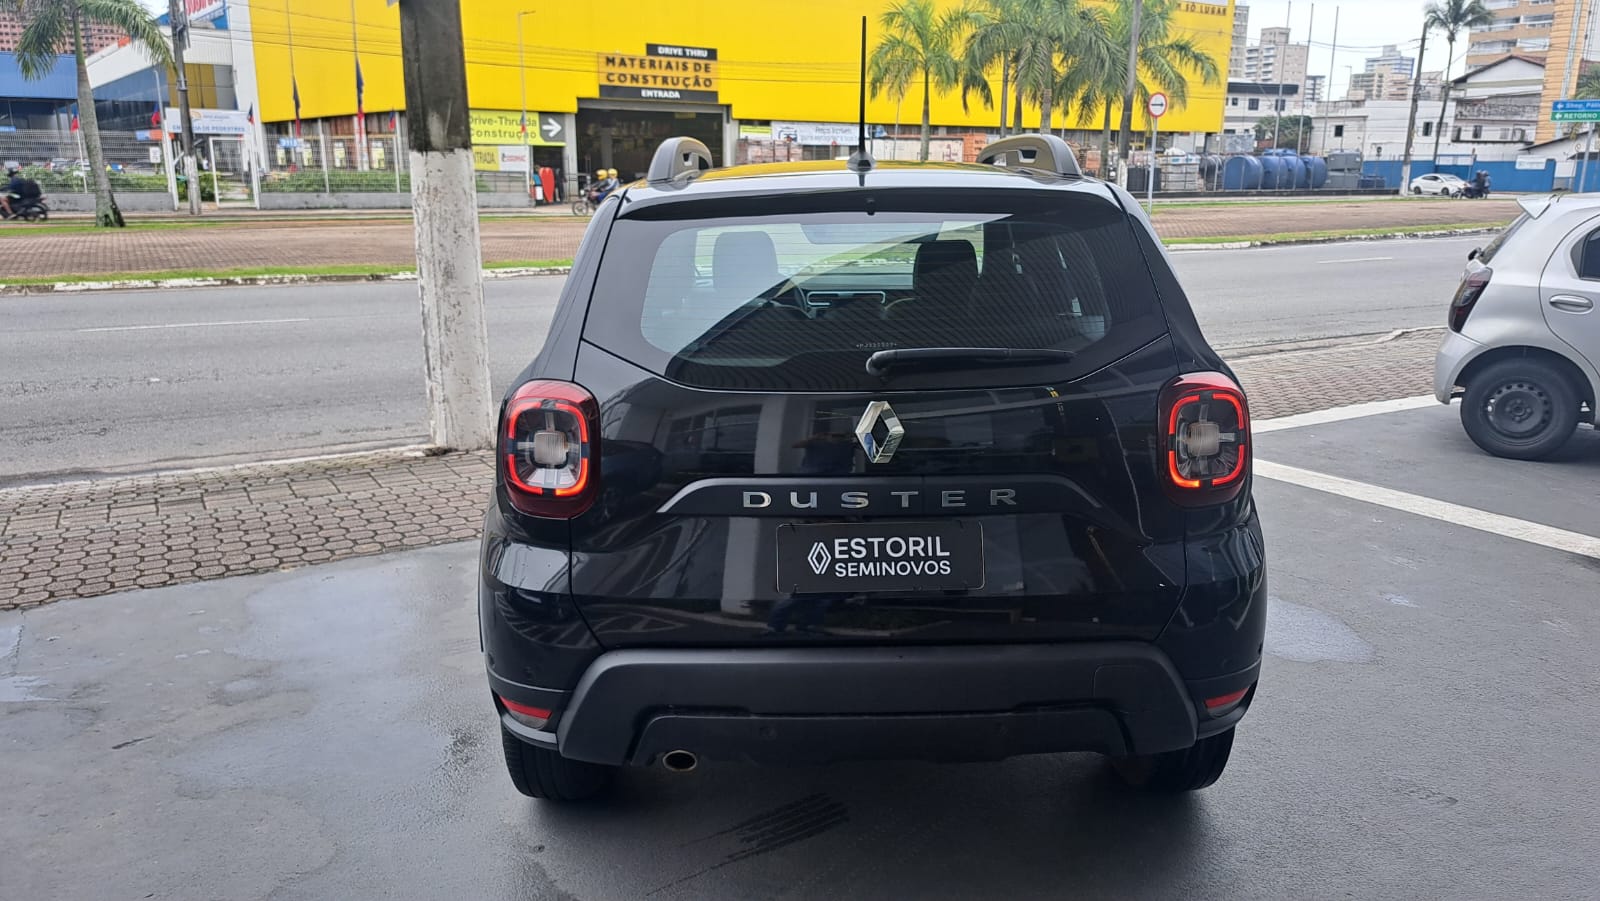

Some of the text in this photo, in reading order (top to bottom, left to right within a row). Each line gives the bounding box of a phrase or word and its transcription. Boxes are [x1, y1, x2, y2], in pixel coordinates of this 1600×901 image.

[1200, 5, 1226, 16] LUGAR
[657, 46, 708, 58] DRIVE THRU
[605, 56, 712, 73] MATERIAIS DE
[606, 72, 713, 89] CONSTRUÇÃO
[641, 89, 681, 99] ENTRADA
[471, 129, 537, 141] onstruço
[742, 488, 1017, 509] DUSTER
[834, 536, 950, 559] ESTORIL
[834, 560, 951, 578] SEMINOVOS
